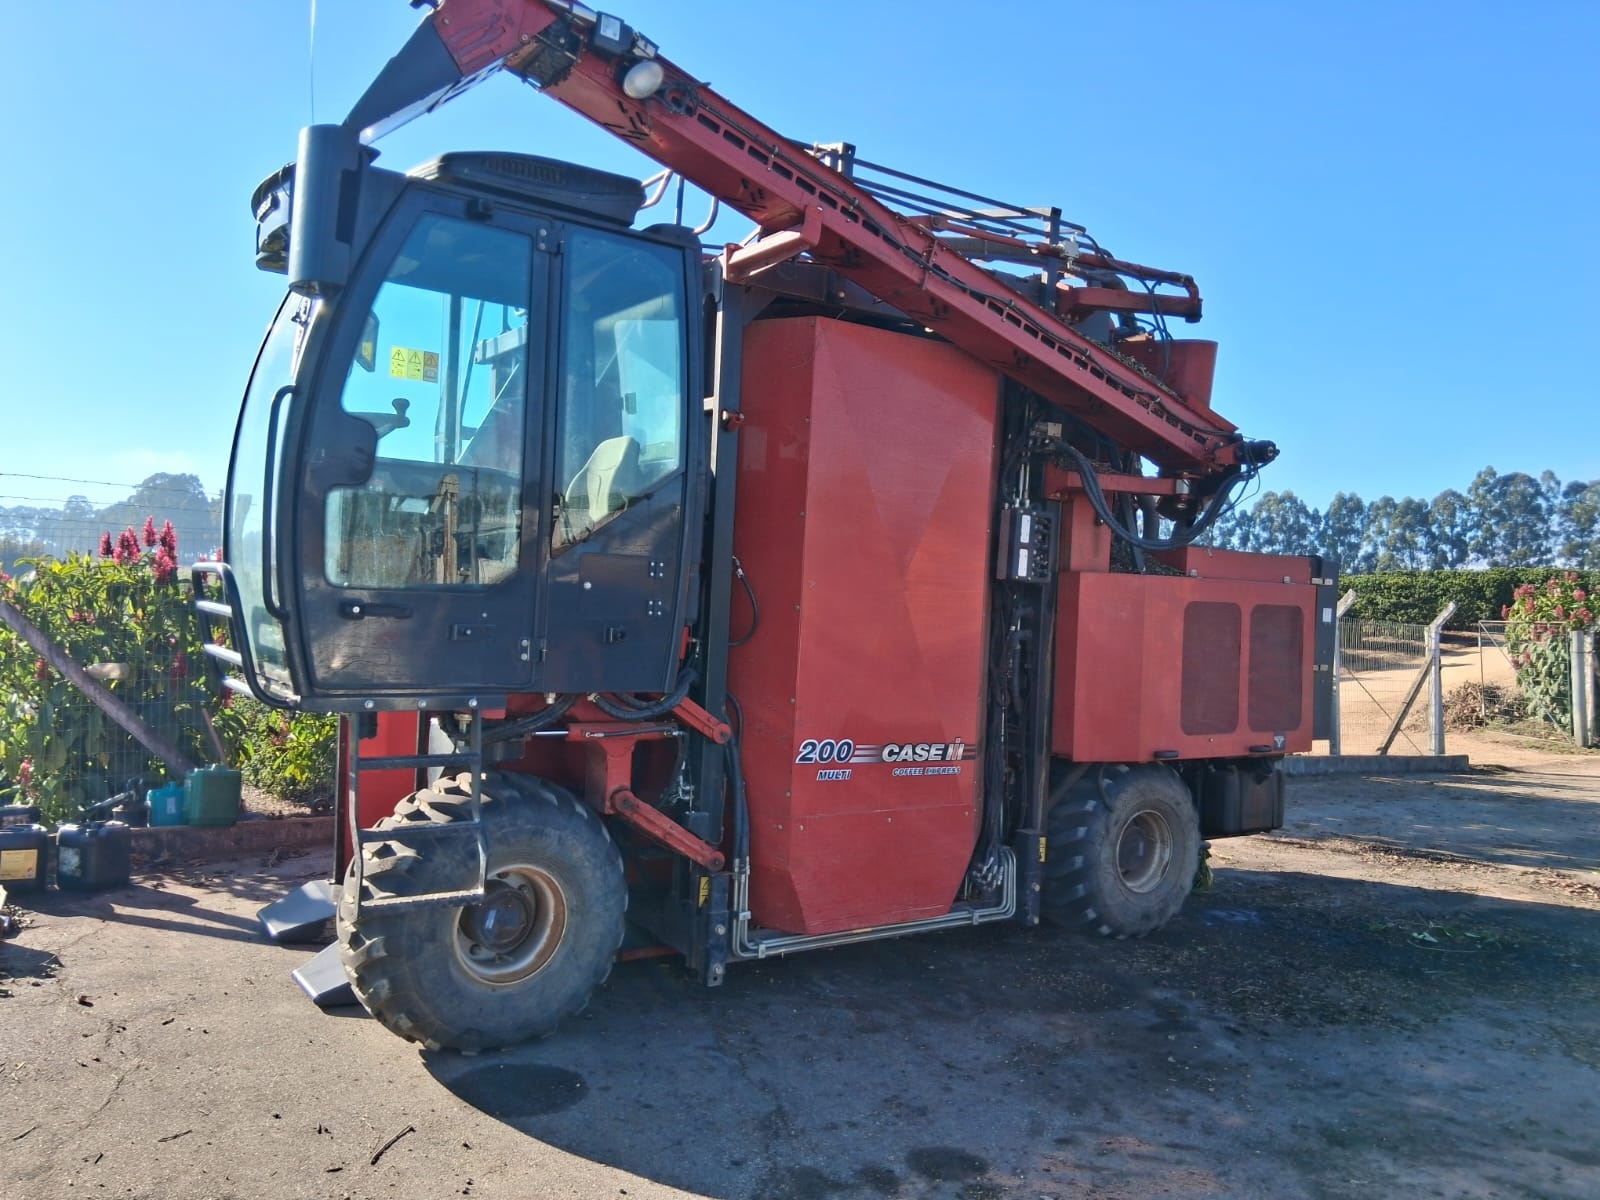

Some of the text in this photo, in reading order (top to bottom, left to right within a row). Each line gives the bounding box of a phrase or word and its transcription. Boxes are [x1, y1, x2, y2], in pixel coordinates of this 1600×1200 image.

[795, 738, 854, 763] 200
[881, 743, 945, 763] CASE
[816, 769, 852, 781] MULTI
[892, 767, 923, 777] COFFEE
